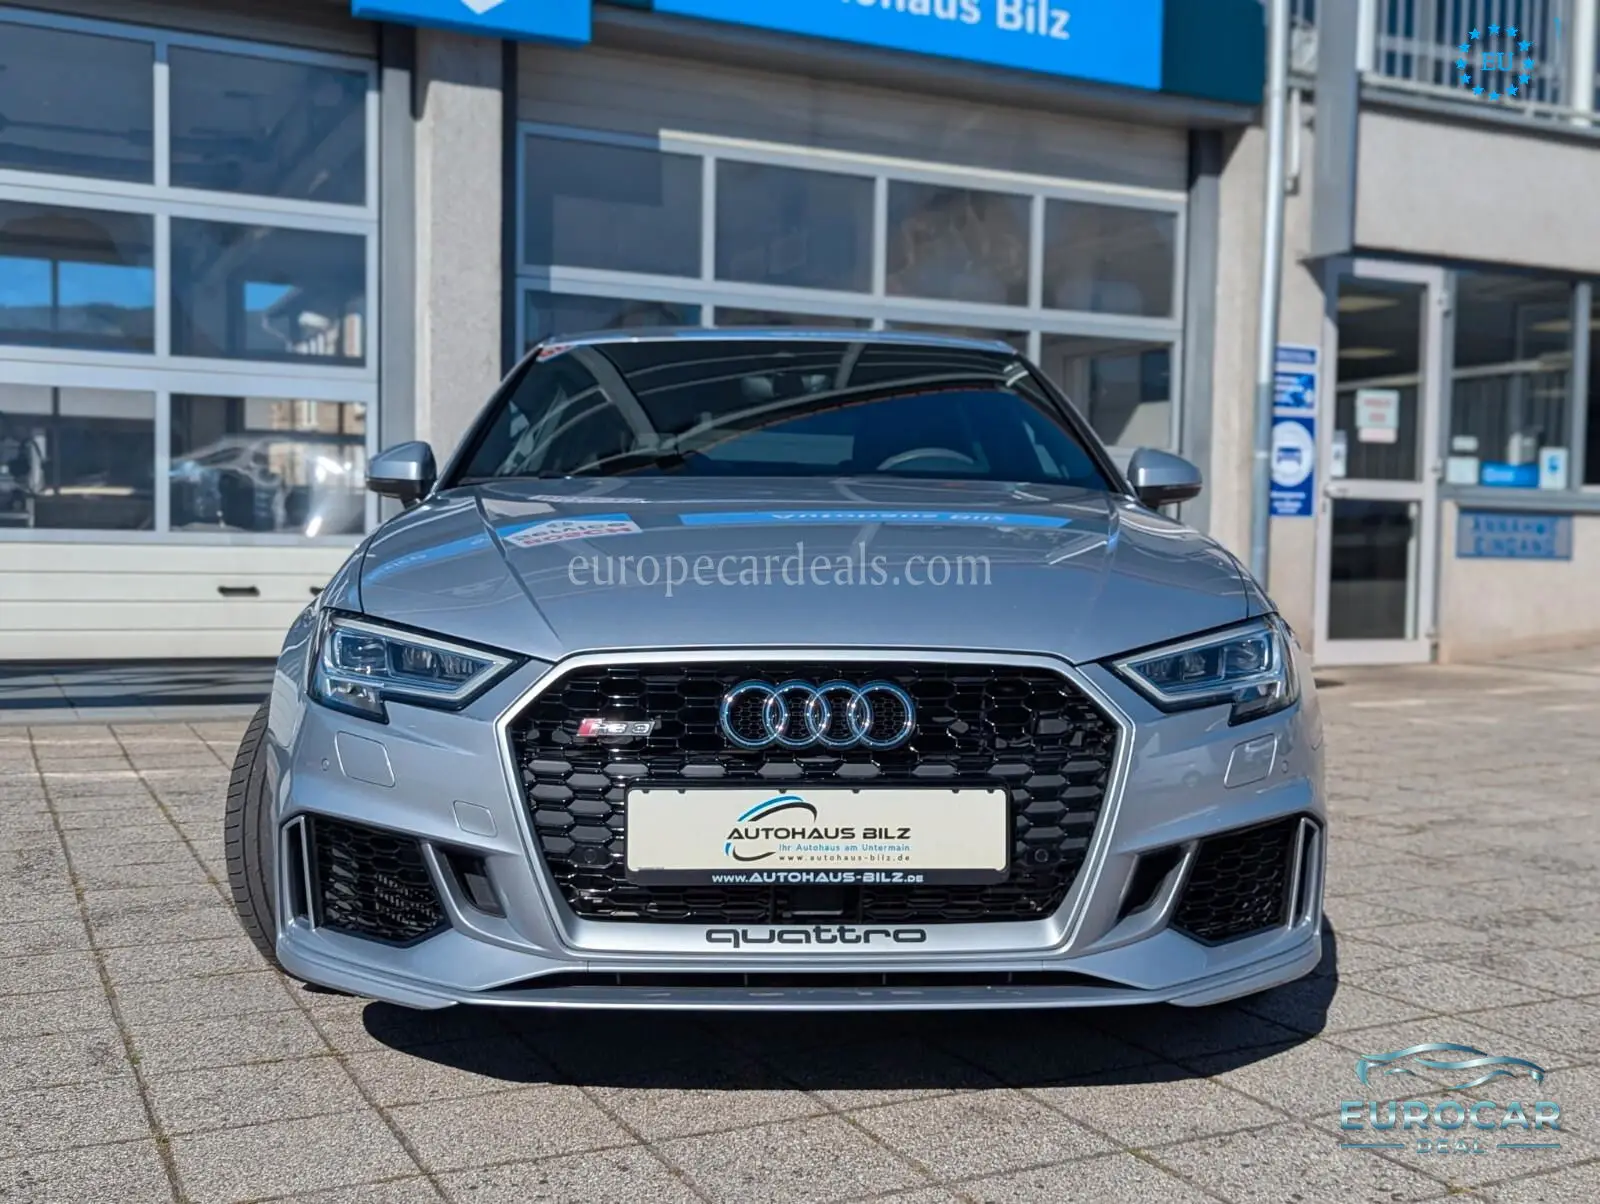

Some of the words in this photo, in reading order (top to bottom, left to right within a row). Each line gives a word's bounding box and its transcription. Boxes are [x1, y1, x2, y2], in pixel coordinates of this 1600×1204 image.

[842, 0, 982, 25] aus
[996, 0, 1072, 40] Bilz
[727, 827, 856, 840] AUTOHAUS
[862, 827, 912, 840] BILZ
[779, 843, 793, 852] Ihr
[796, 843, 840, 852] Autohaus
[862, 843, 911, 852] Untermain
[779, 854, 911, 862] www.autohaus-bilz.de
[705, 925, 927, 949] quattro
